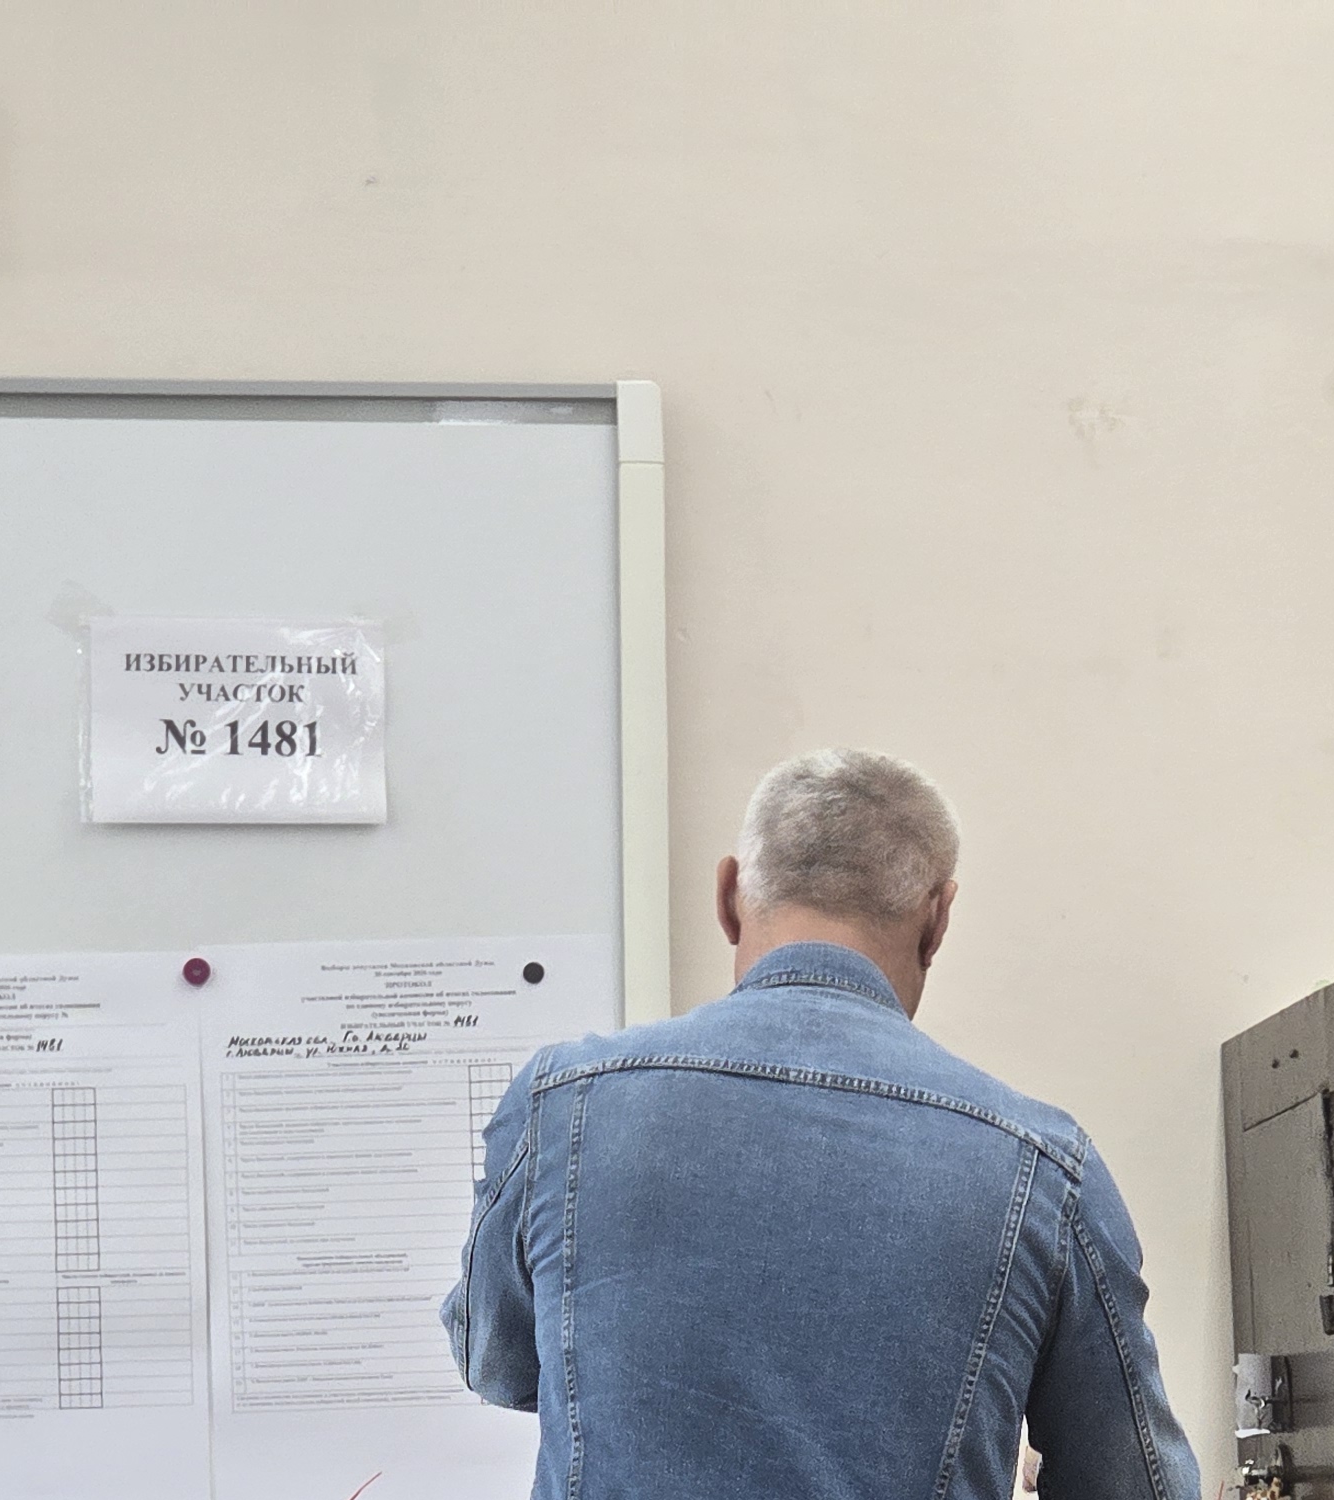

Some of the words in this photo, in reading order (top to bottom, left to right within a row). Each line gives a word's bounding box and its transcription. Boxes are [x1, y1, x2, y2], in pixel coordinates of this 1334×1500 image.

[124, 652, 358, 675] ИЗБИРАТЕЛЬНЫЙ
[178, 682, 306, 703] УЧАСТОК
[155, 718, 207, 755] №
[224, 719, 323, 758] 1481
